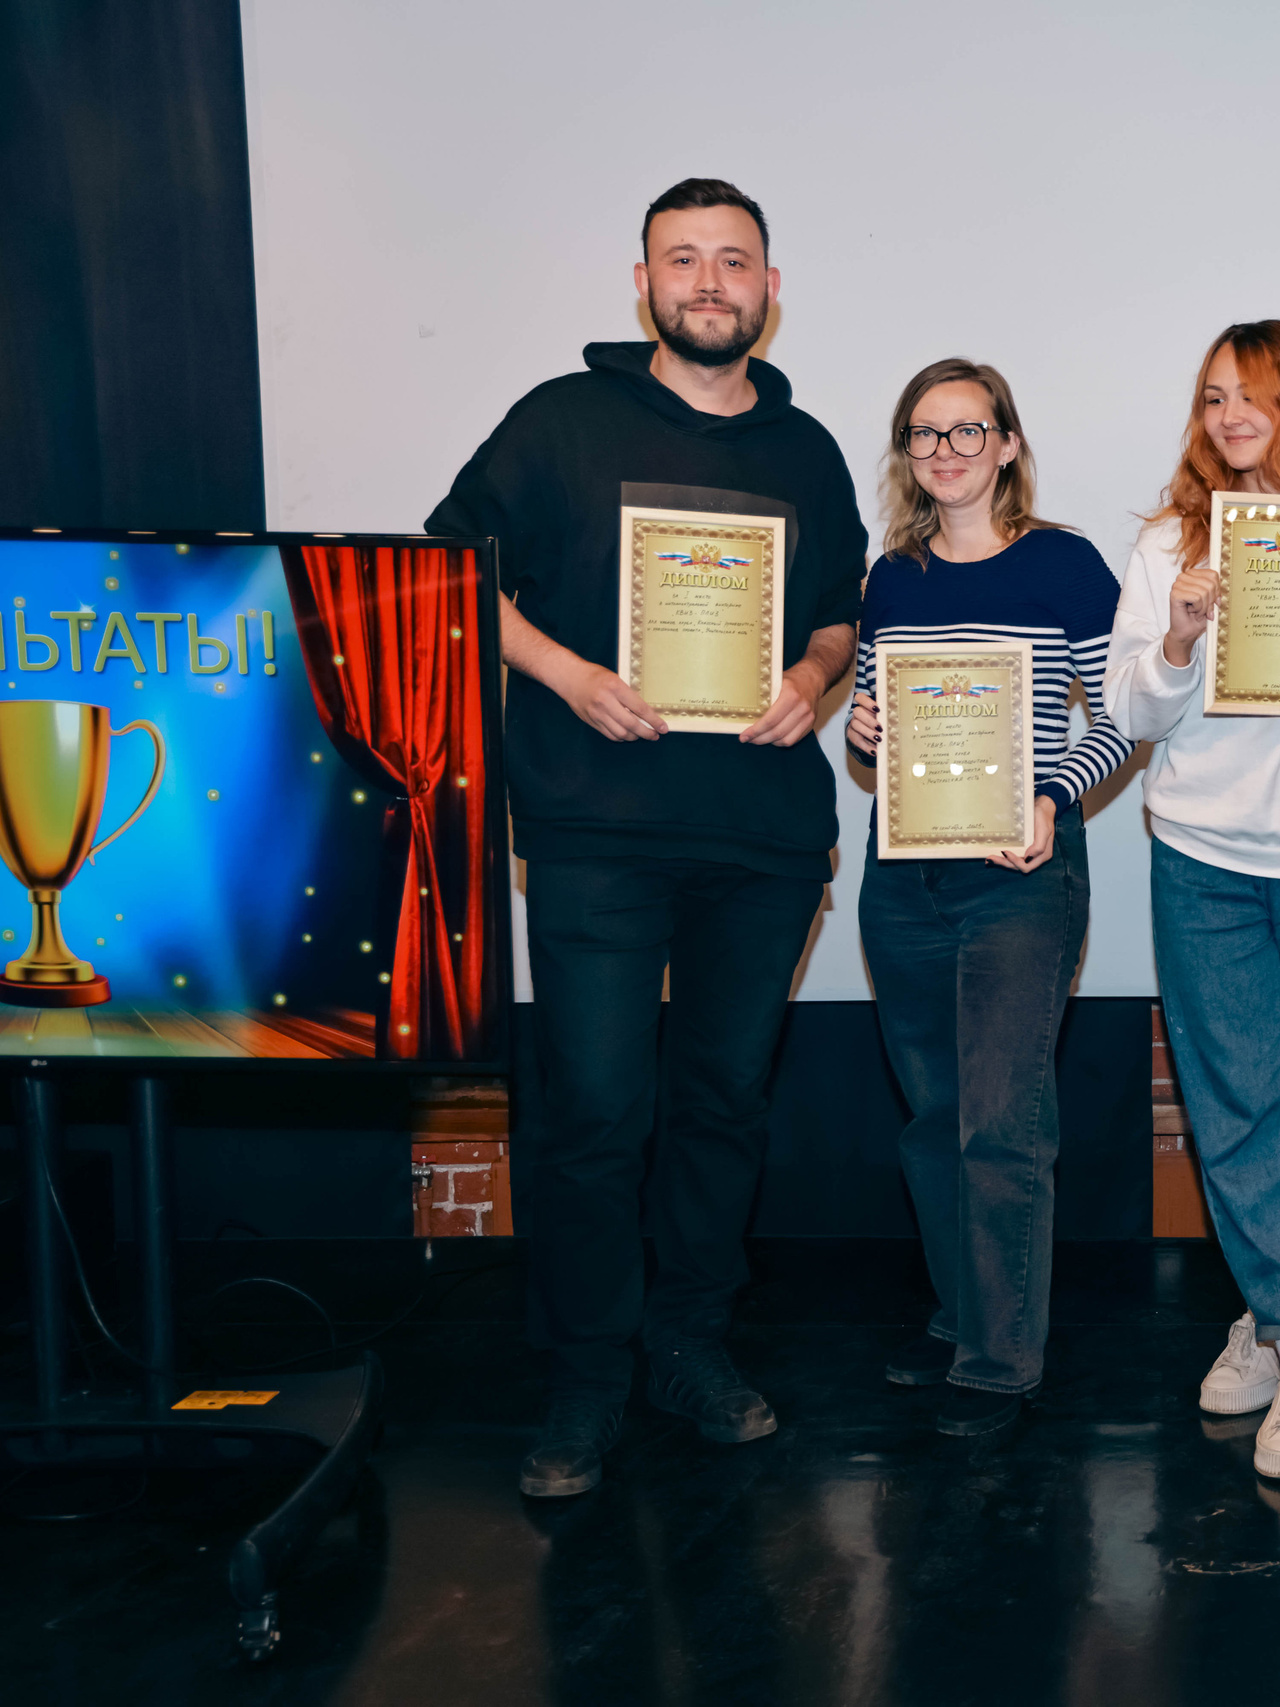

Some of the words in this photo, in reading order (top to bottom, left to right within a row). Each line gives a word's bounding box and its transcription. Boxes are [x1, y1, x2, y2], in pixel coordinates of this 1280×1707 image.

[660, 572, 748, 590] ДИПЛОМ
[0, 610, 277, 676] ЬТАТЫ!
[914, 704, 998, 720] ДИПЛОМ
